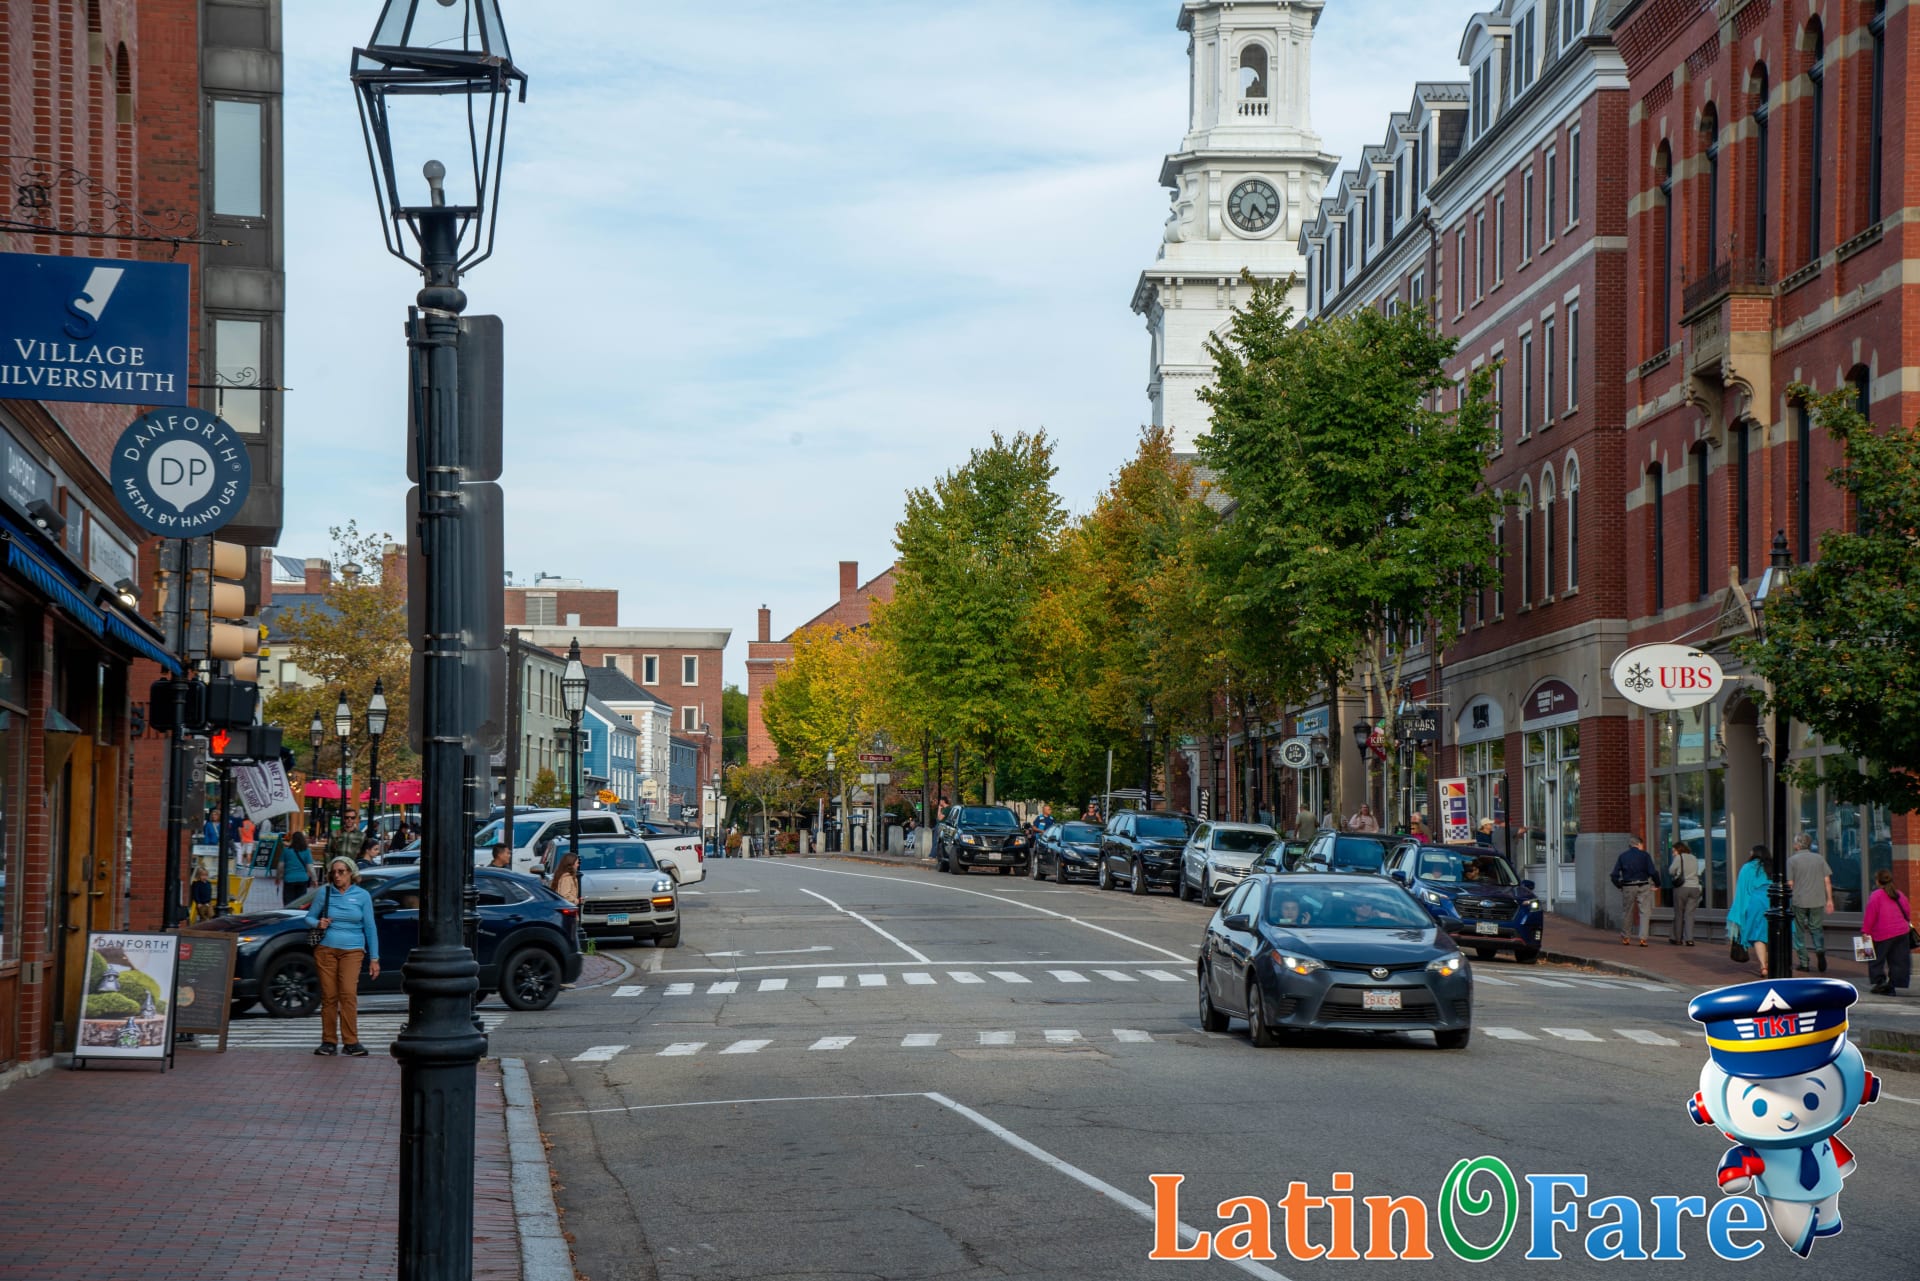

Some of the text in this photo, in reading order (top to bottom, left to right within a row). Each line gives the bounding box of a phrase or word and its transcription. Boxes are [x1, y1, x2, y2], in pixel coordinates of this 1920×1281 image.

[14, 338, 145, 366] VILLAGE
[0, 365, 175, 392] ILVERSMITH
[124, 416, 238, 461] DANFORTH
[161, 458, 207, 486] DP
[124, 478, 238, 527] METAL BY HAND USA
[1659, 666, 1712, 689] UBS
[1441, 786, 1451, 838] OPEN
[98, 939, 169, 949] DANFORTH
